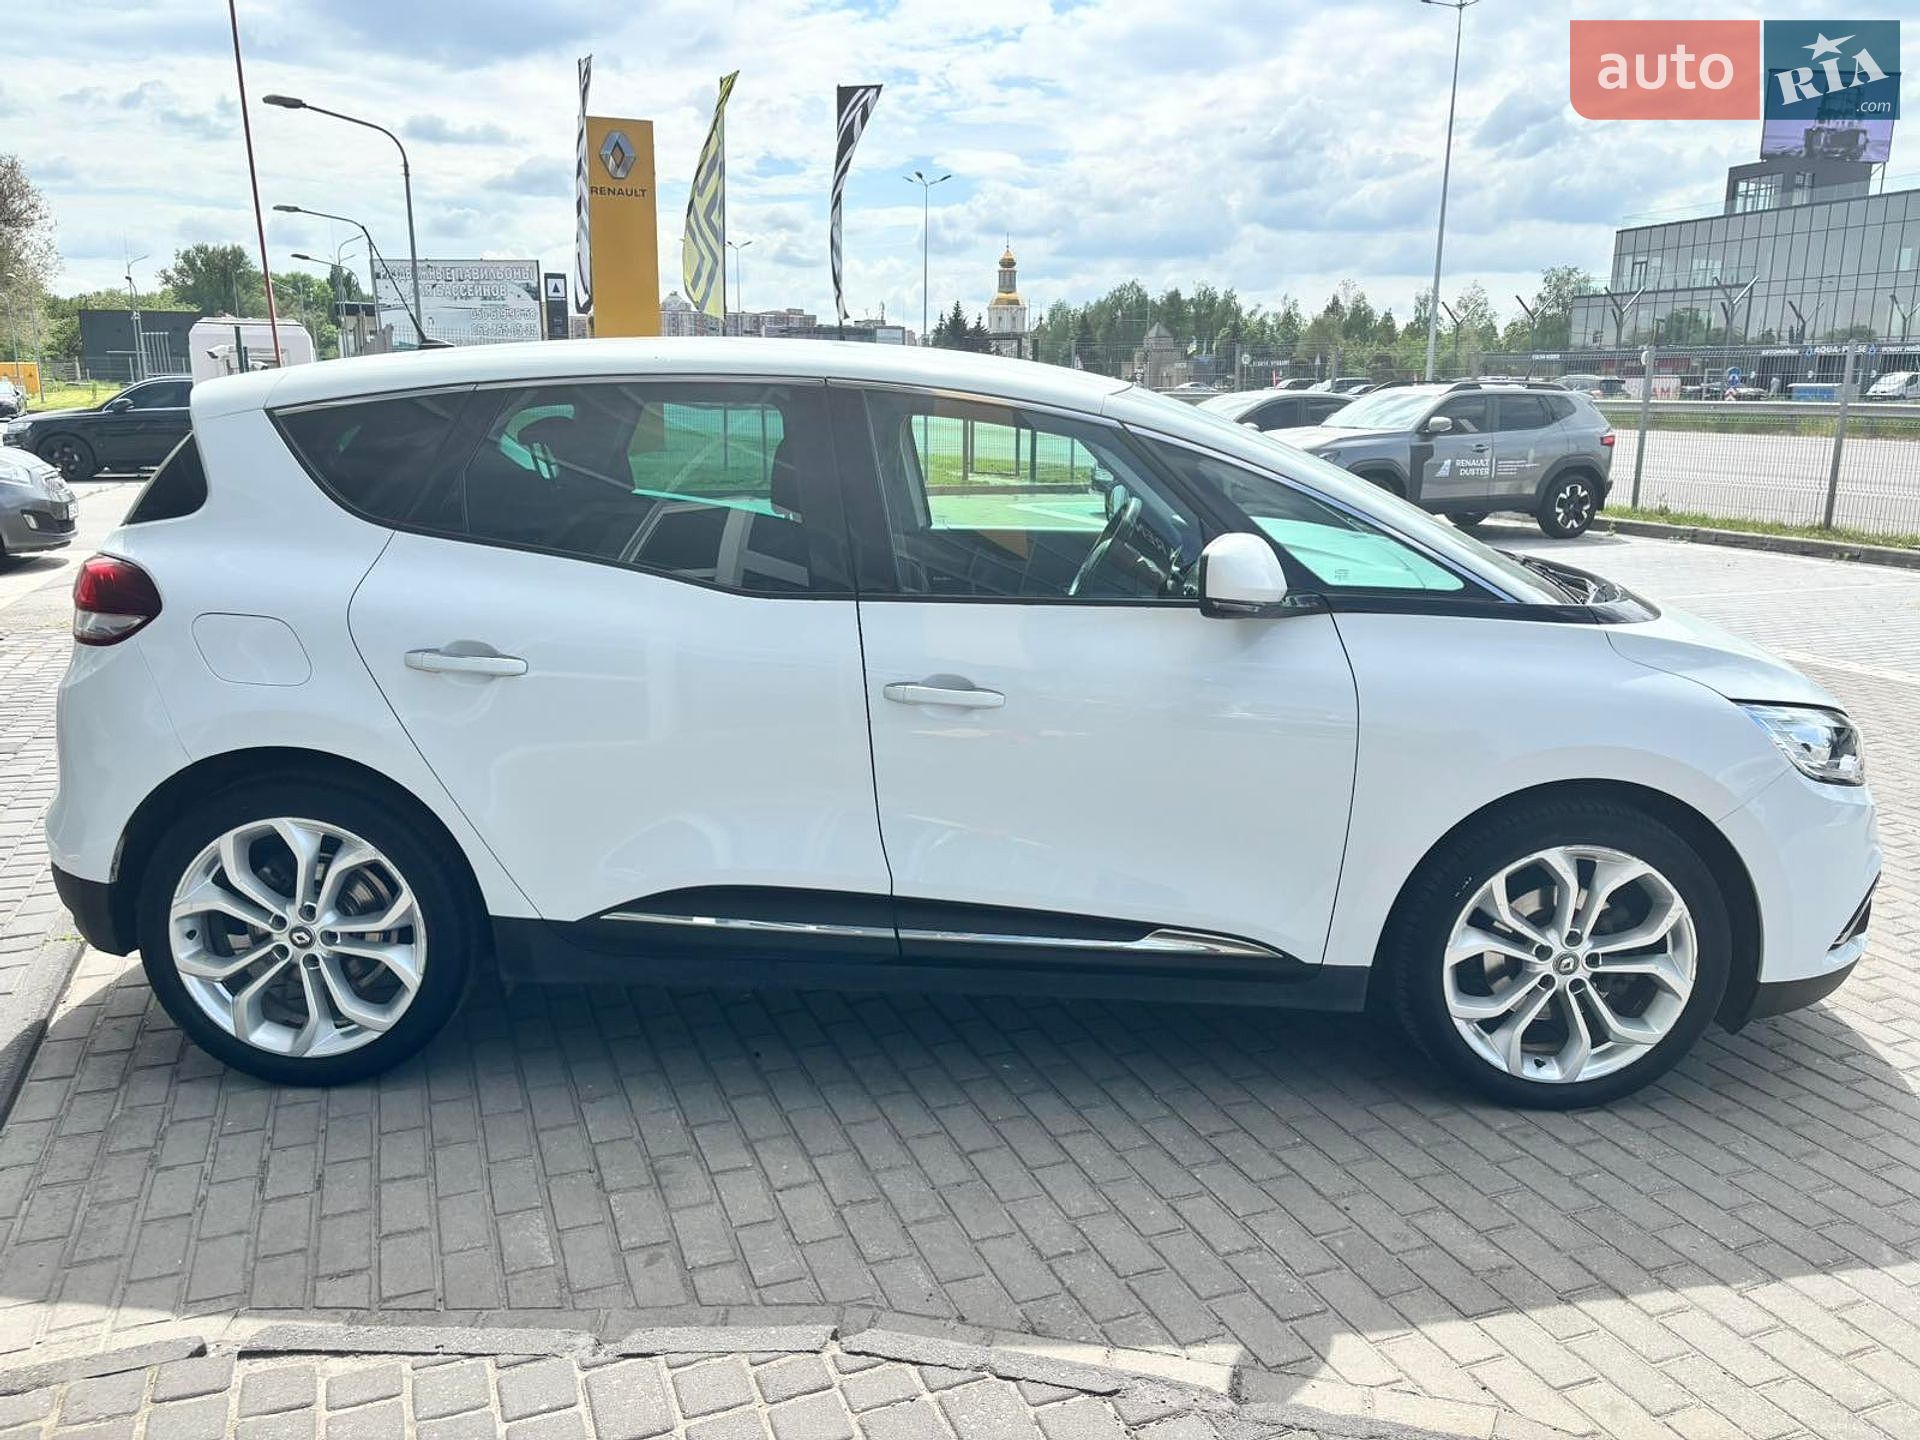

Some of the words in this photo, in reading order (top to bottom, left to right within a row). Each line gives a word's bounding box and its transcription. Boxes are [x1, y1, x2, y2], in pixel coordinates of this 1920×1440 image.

[590, 186, 647, 197] RENAULT
[380, 266, 452, 281] РАЗДВЖНЫЕ
[453, 266, 534, 281] ПАВИЛЬОНЫ
[1456, 459, 1490, 467] RENAULT
[1460, 467, 1490, 476] DUSTER
